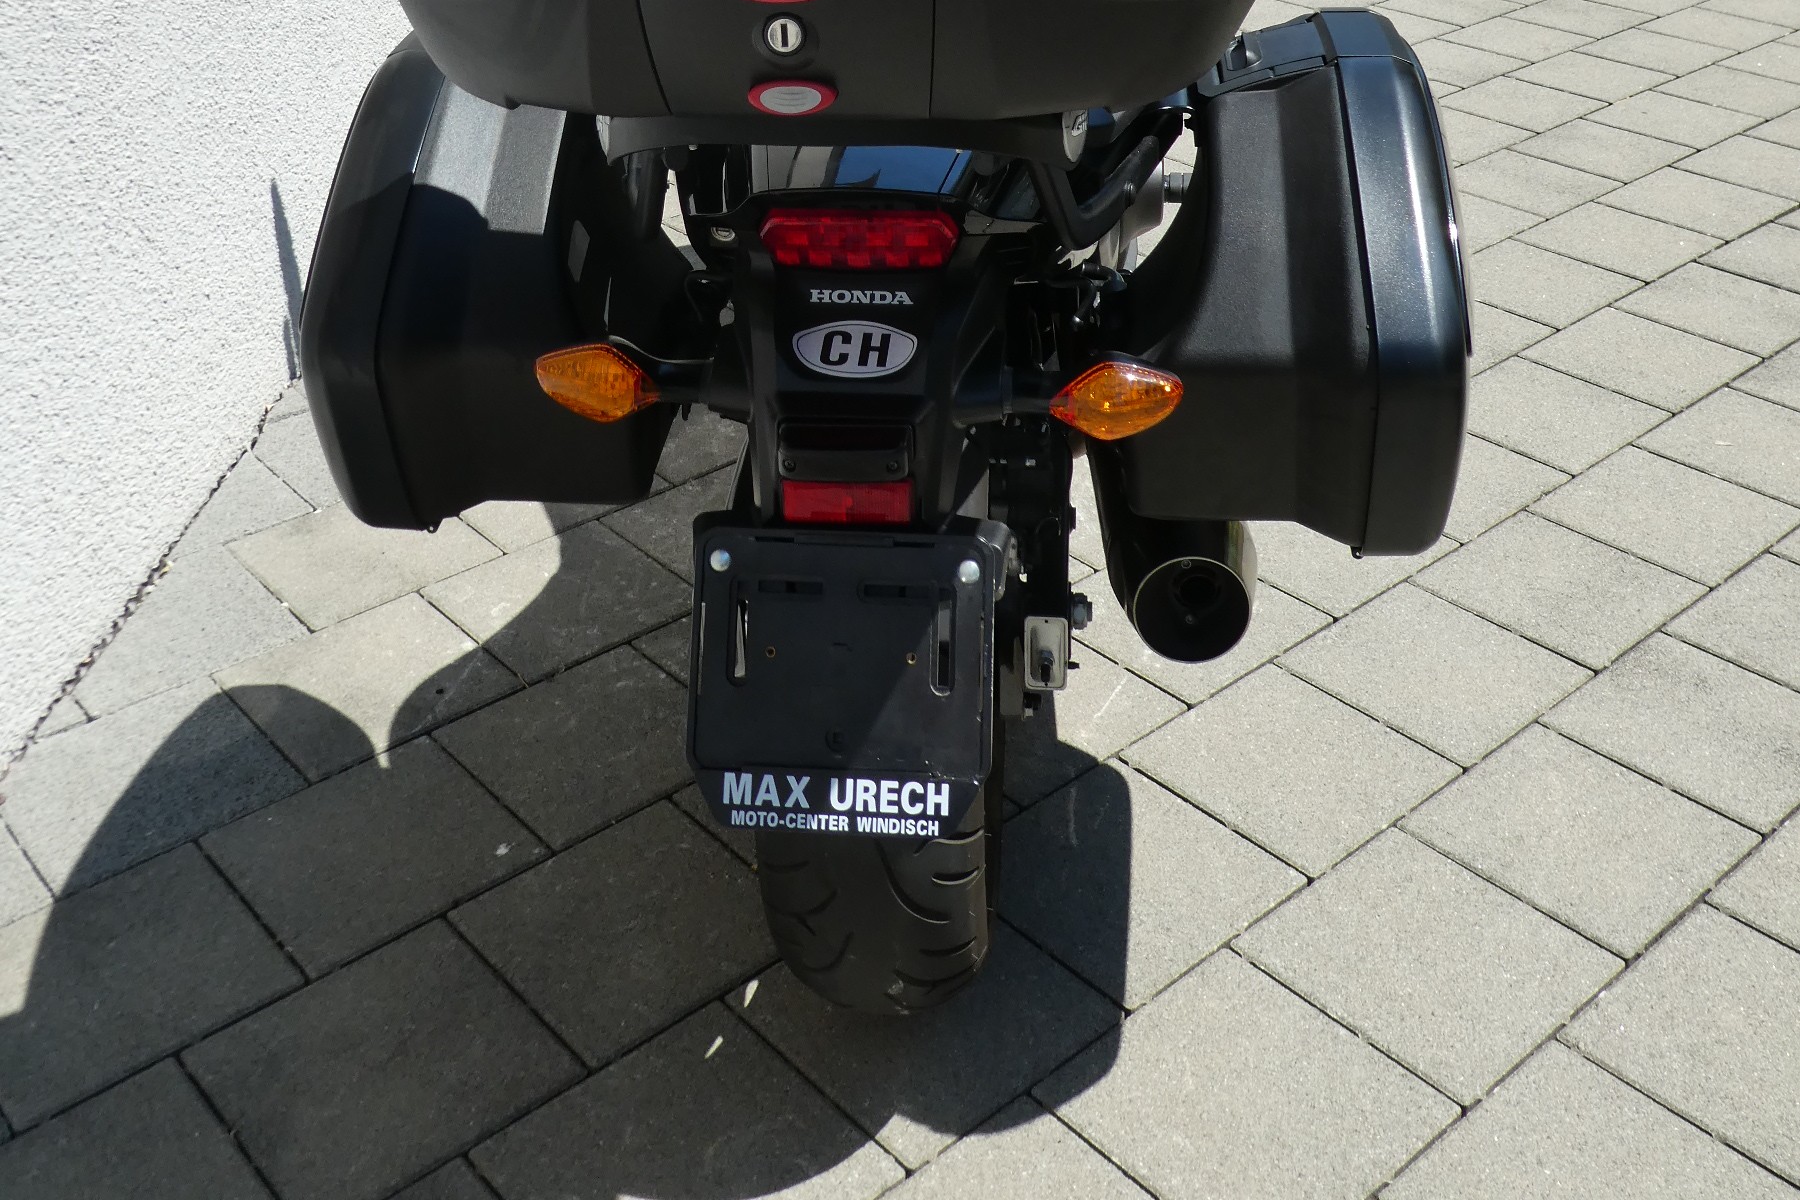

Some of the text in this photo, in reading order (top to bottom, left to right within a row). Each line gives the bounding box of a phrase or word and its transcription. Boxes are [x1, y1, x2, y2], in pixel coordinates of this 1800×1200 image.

[809, 289, 913, 305] HONDA
[819, 330, 892, 368] CH
[722, 771, 950, 816] MAX URECH
[730, 809, 939, 837] MOTO-CENTER WINDISCH
